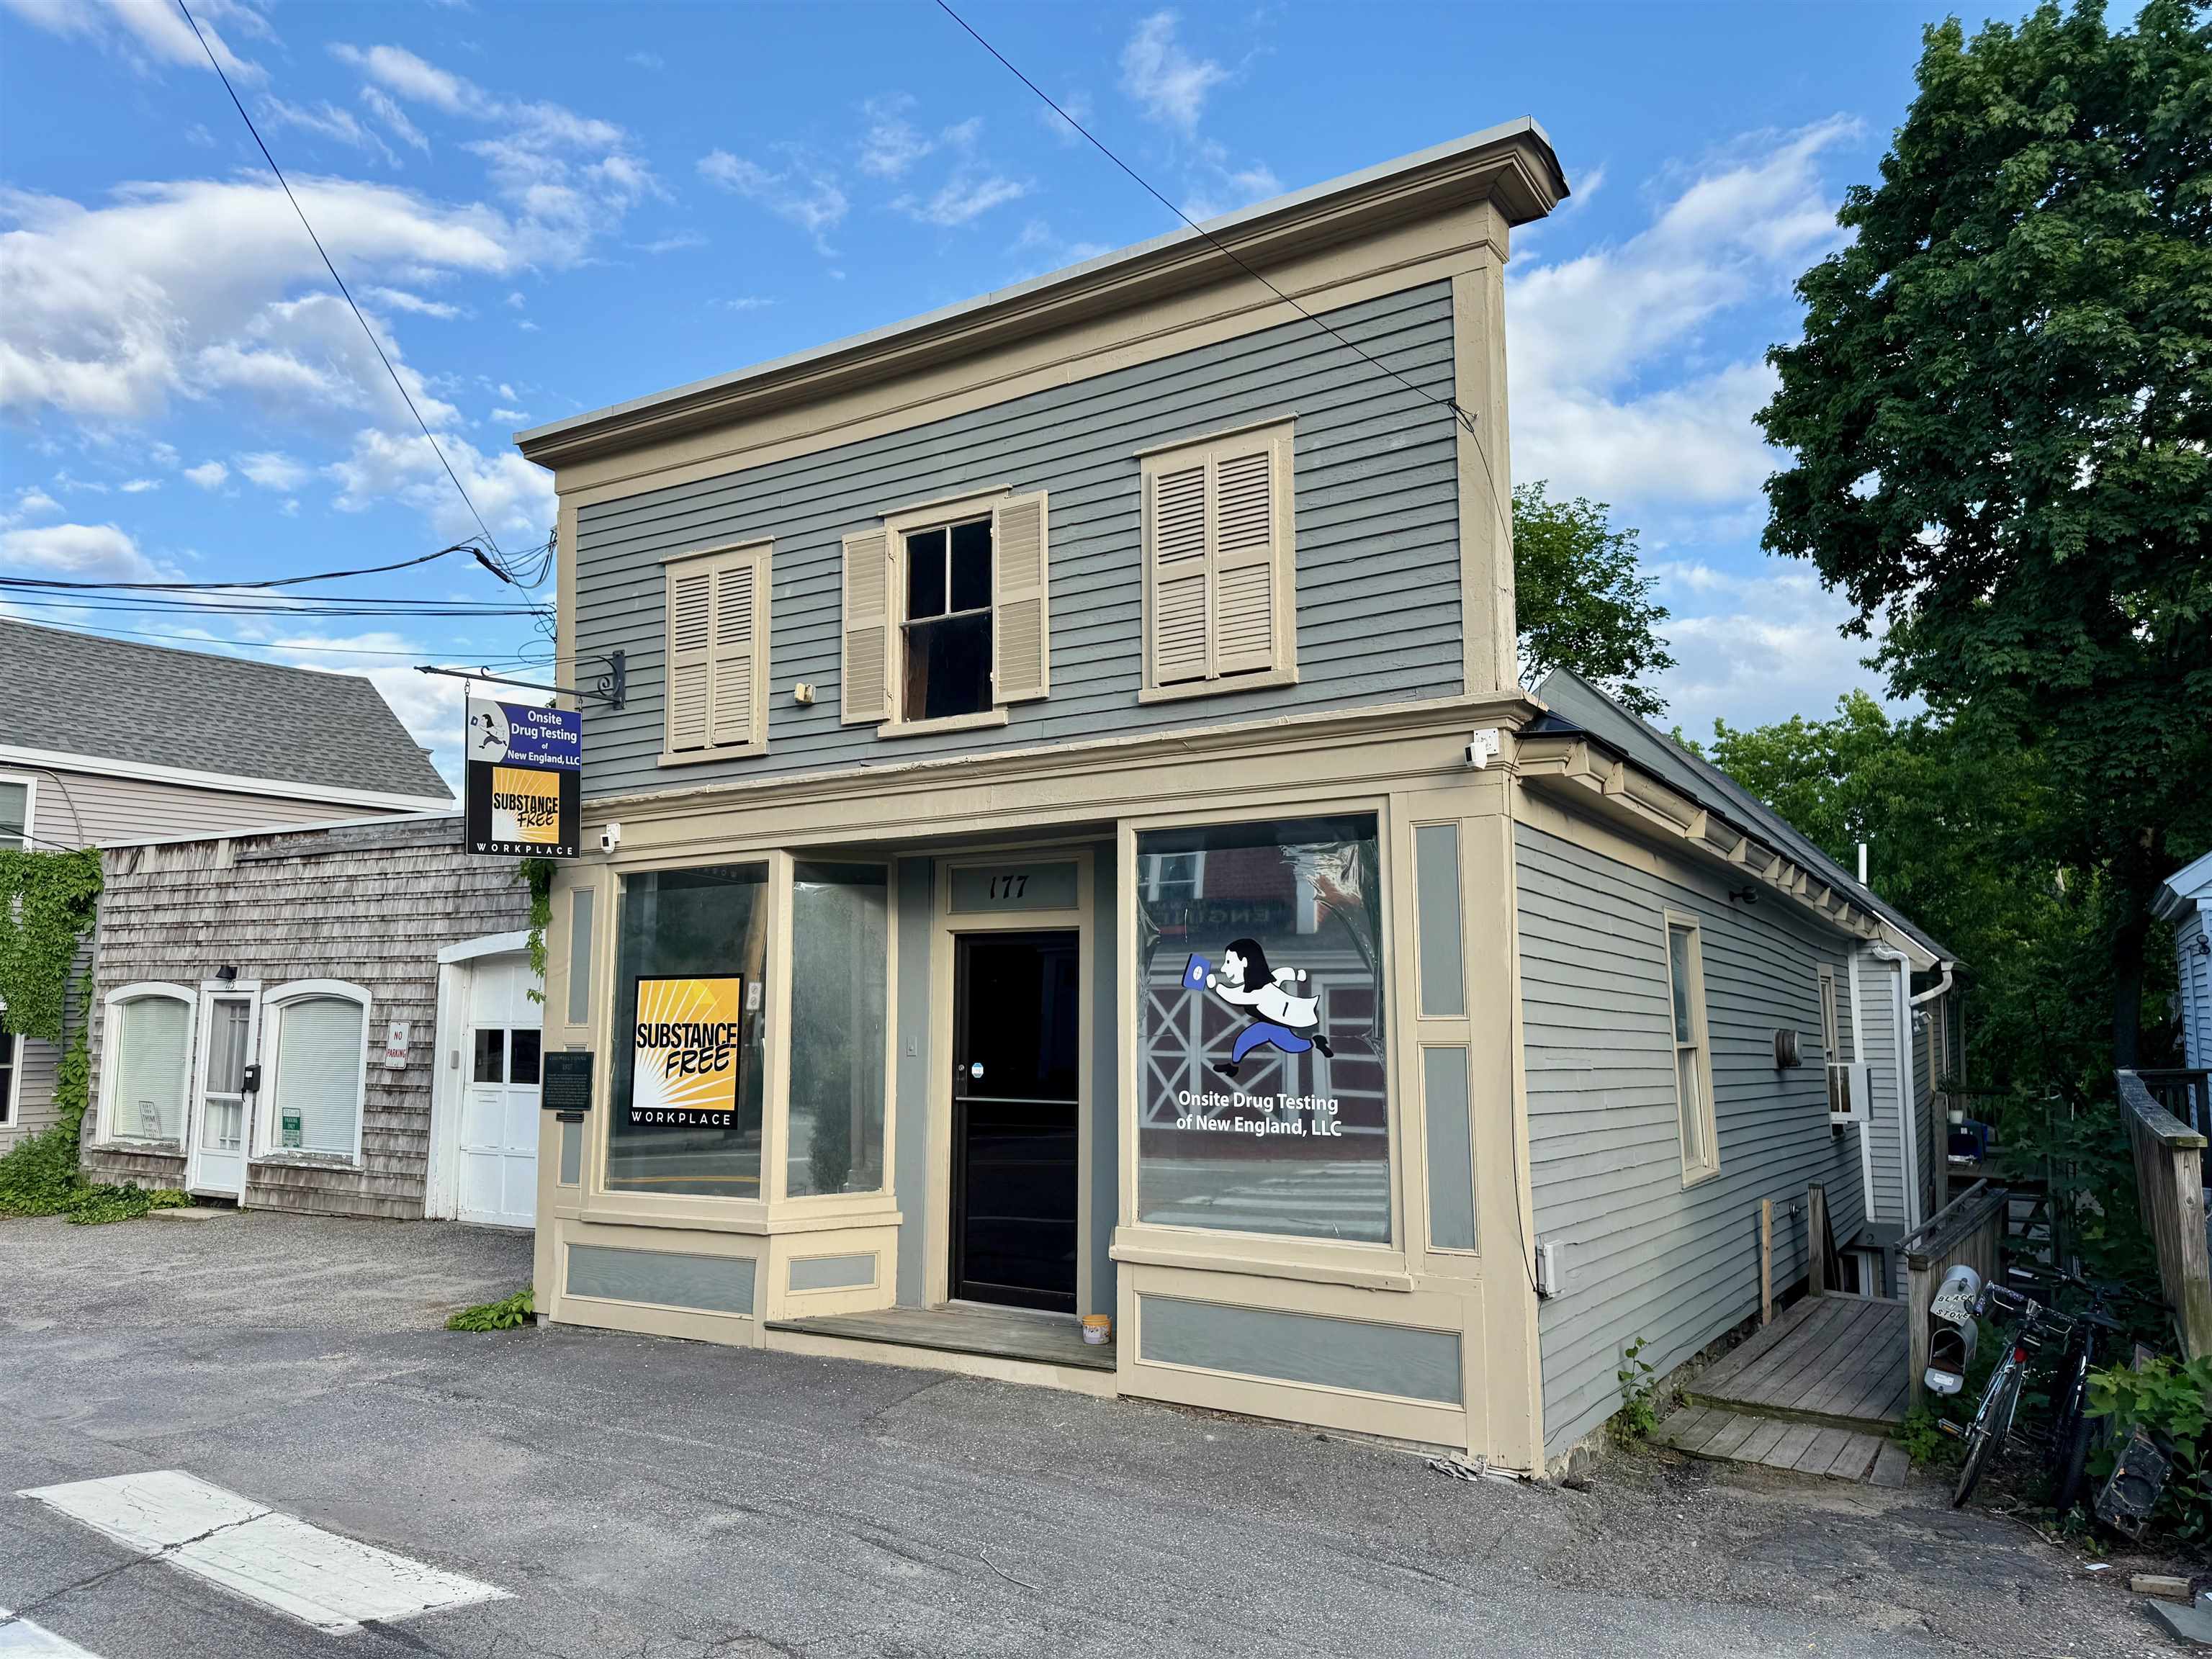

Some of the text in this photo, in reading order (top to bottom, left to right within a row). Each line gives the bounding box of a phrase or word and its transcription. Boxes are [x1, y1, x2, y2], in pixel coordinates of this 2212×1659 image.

[528, 711, 562, 725] Onsite
[511, 723, 577, 744] Drug Testing
[508, 750, 580, 765] New England, LLC
[493, 793, 559, 814] SUBSTANCE
[517, 811, 554, 828] FREE
[477, 842, 573, 855] WORKPLACE
[989, 874, 1030, 899] 177
[393, 1030, 403, 1040] NO
[637, 1022, 737, 1049] SUBSTANCE
[386, 1048, 407, 1059] PARKING
[665, 1043, 732, 1079] FREE
[1178, 1089, 1339, 1115] Onsite Drug Testing
[631, 1111, 731, 1125] WORKPLACE
[1176, 1114, 1342, 1138] of New England, LLC
[1866, 1233, 1875, 1245] 2
[1937, 1294, 1975, 1303] BLACK
[1936, 1309, 1969, 1320] STONE
